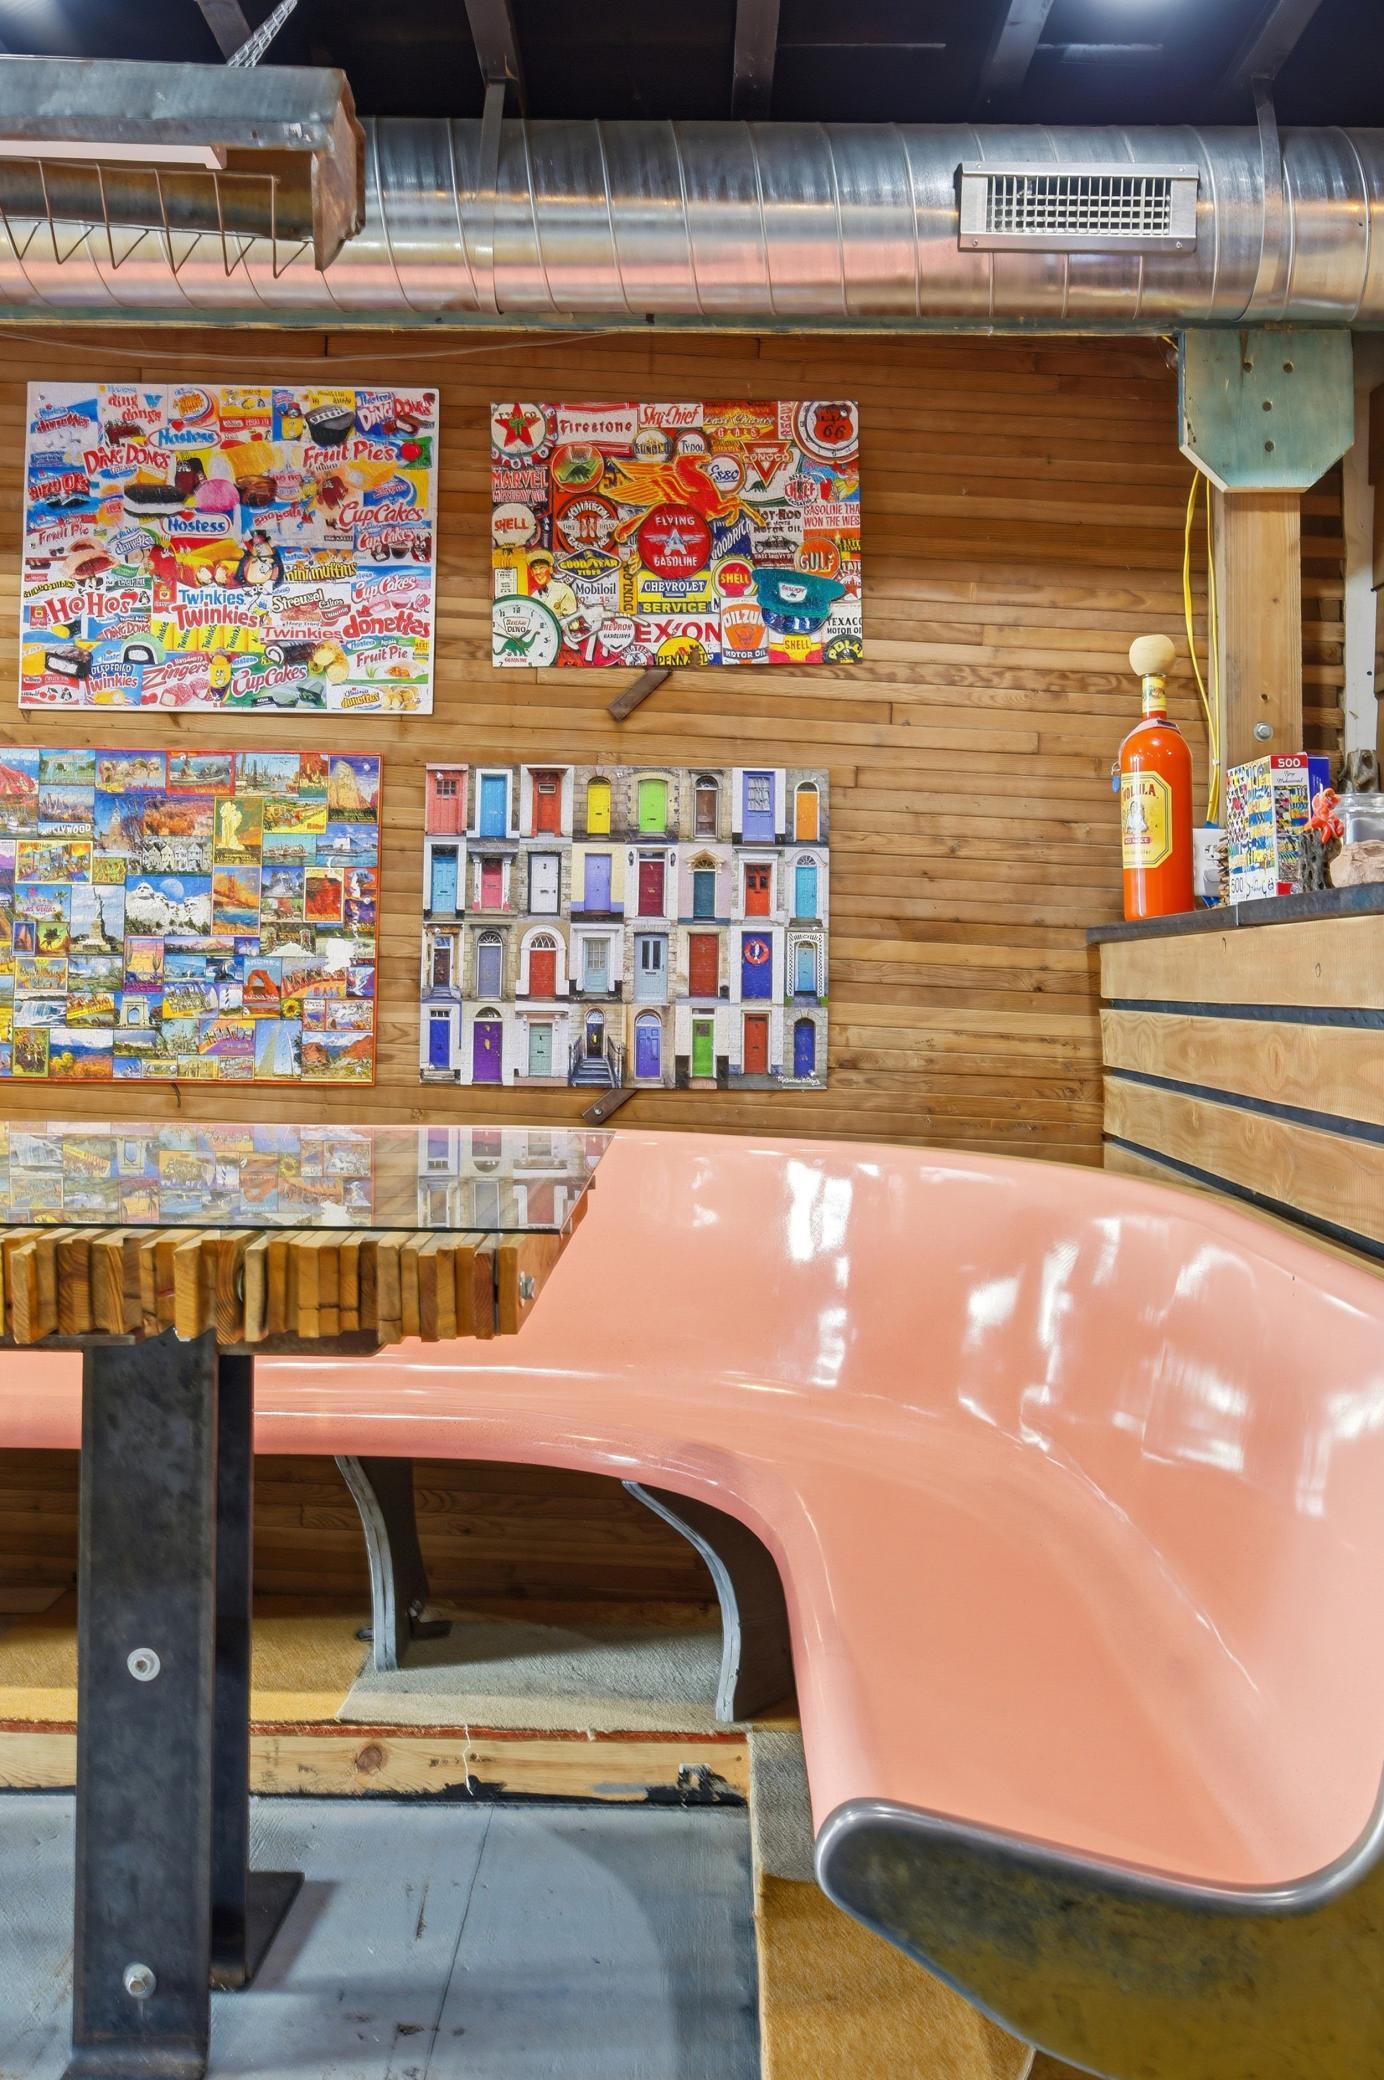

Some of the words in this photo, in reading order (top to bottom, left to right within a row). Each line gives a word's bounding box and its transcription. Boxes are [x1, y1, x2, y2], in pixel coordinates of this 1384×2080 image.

[559, 419, 632, 434] Firestone
[823, 424, 846, 440] 66
[158, 427, 215, 446] Hostess
[303, 440, 349, 468] Fruit
[353, 439, 394, 461] Pies
[710, 464, 739, 480] Esso
[492, 470, 548, 490] MARVEL
[804, 504, 840, 515] GASOLINE
[167, 514, 226, 532] Hostess
[655, 515, 695, 526] FLYING
[804, 516, 823, 527] WON
[825, 517, 840, 527] THE
[560, 558, 618, 568] GOODYEAR
[654, 556, 698, 567] GASOLINE
[800, 552, 835, 572] GULF
[720, 573, 749, 584] SHELL
[576, 582, 616, 595] Mobiloil
[644, 581, 705, 592] CHEVROLET
[178, 588, 245, 606] Twinkies
[643, 602, 707, 613] SERVICE
[171, 601, 260, 631] Twinkies
[342, 610, 431, 639] donettes
[263, 626, 344, 640] Twinkies
[785, 640, 810, 650] SHELL
[356, 651, 387, 667] Fruit
[388, 645, 408, 659] Pie
[725, 650, 753, 658] MOTOR
[755, 650, 766, 658] OIL
[85, 671, 137, 694] Twinkies
[1278, 758, 1300, 768] 500
